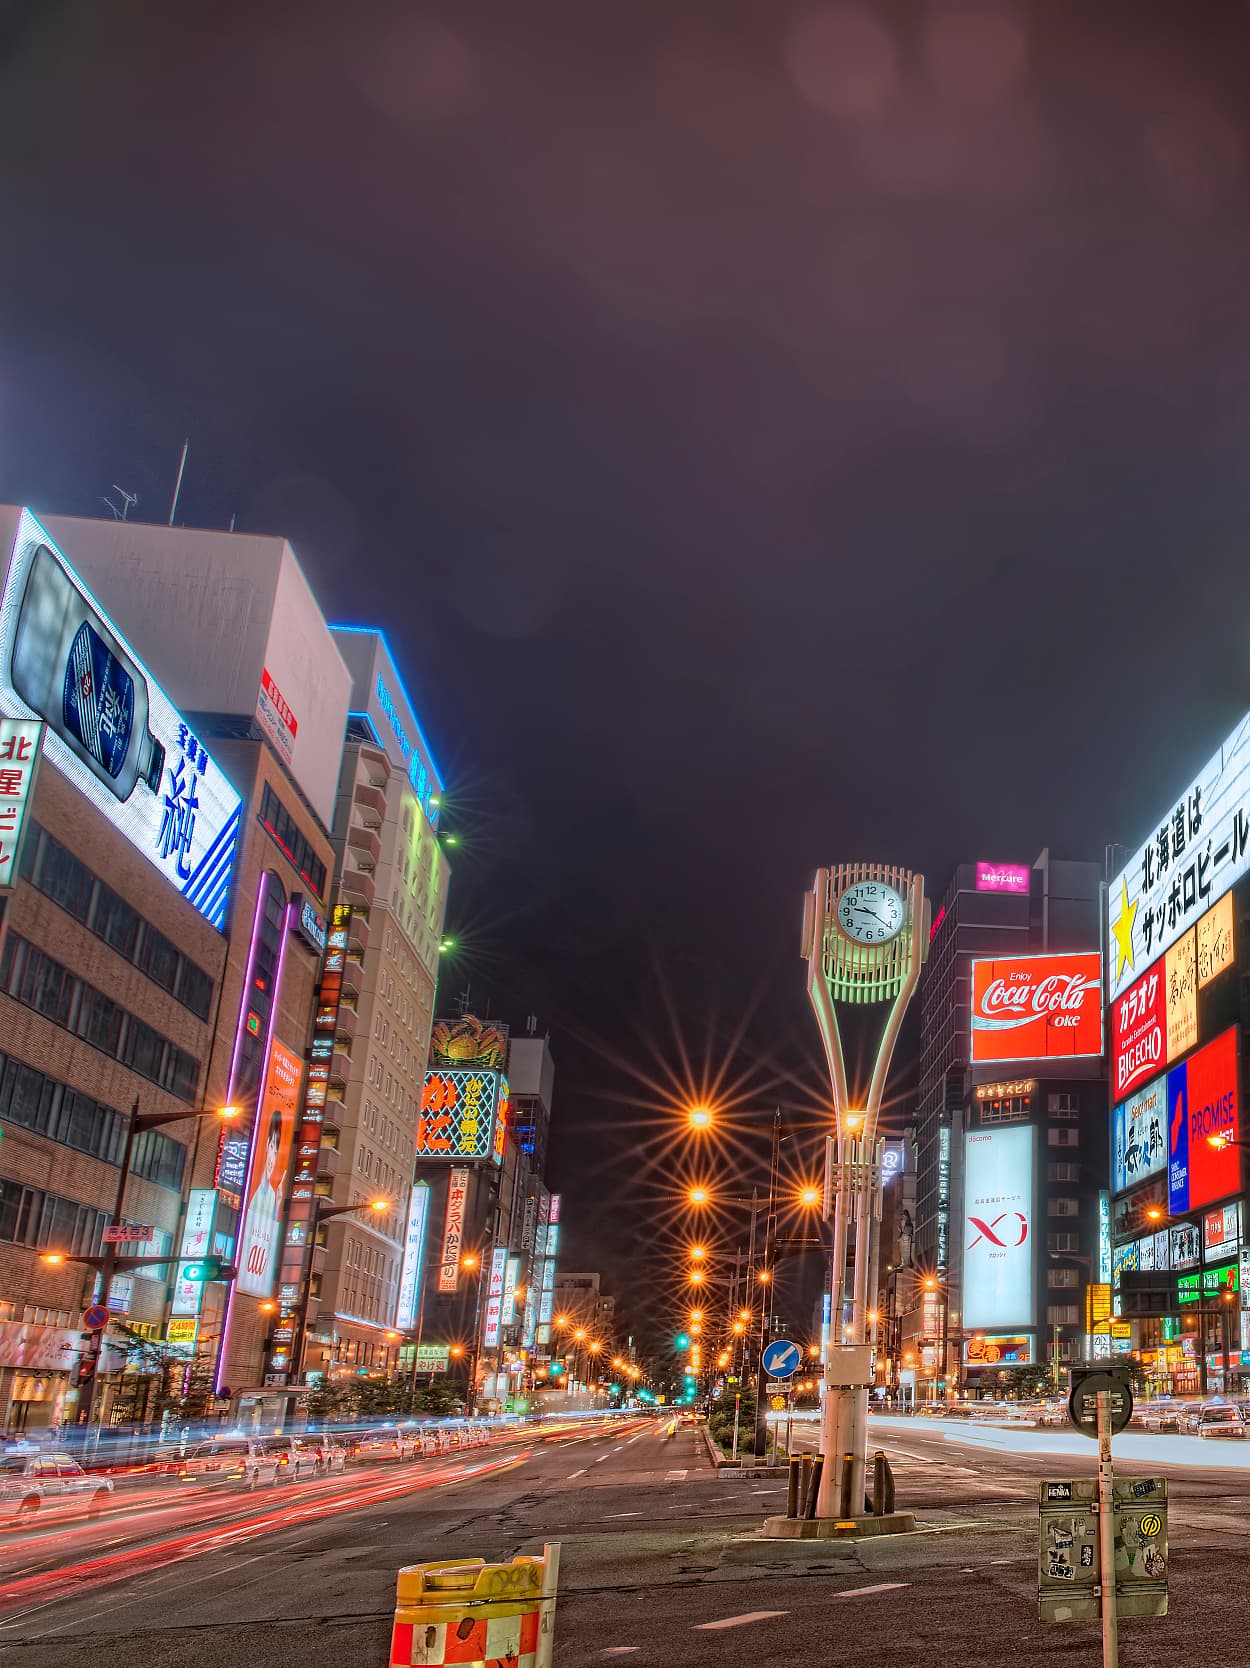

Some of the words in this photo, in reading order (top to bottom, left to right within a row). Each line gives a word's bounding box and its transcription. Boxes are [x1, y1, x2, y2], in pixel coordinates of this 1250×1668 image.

[1141, 784, 1203, 894] 北海道は
[982, 873, 1023, 884] Mercure
[1142, 807, 1250, 956] サッポロビール
[855, 889, 864, 897] 11
[866, 886, 877, 895] 12
[880, 891, 886, 899] 1
[846, 897, 857, 906] 10
[887, 898, 895, 907] 2
[843, 907, 850, 916] 9
[890, 909, 898, 919] 3
[846, 918, 853, 928] 8
[855, 927, 863, 936] 7
[866, 930, 873, 939] 6
[877, 928, 885, 937] 5
[1010, 972, 1033, 982] Enjoy
[981, 974, 1087, 1015] Coca-Cola
[1119, 973, 1159, 1034] カラオケ
[1048, 1012, 1080, 1027] Coke
[1118, 1052, 1135, 1090] BIG
[1135, 1025, 1162, 1065] ECHO
[1191, 1091, 1235, 1143] PROMISE
[968, 1135, 992, 1143] docomo
[967, 1212, 1028, 1250] Xi
[247, 1245, 267, 1276] au
[171, 1321, 196, 1331] 24時間
